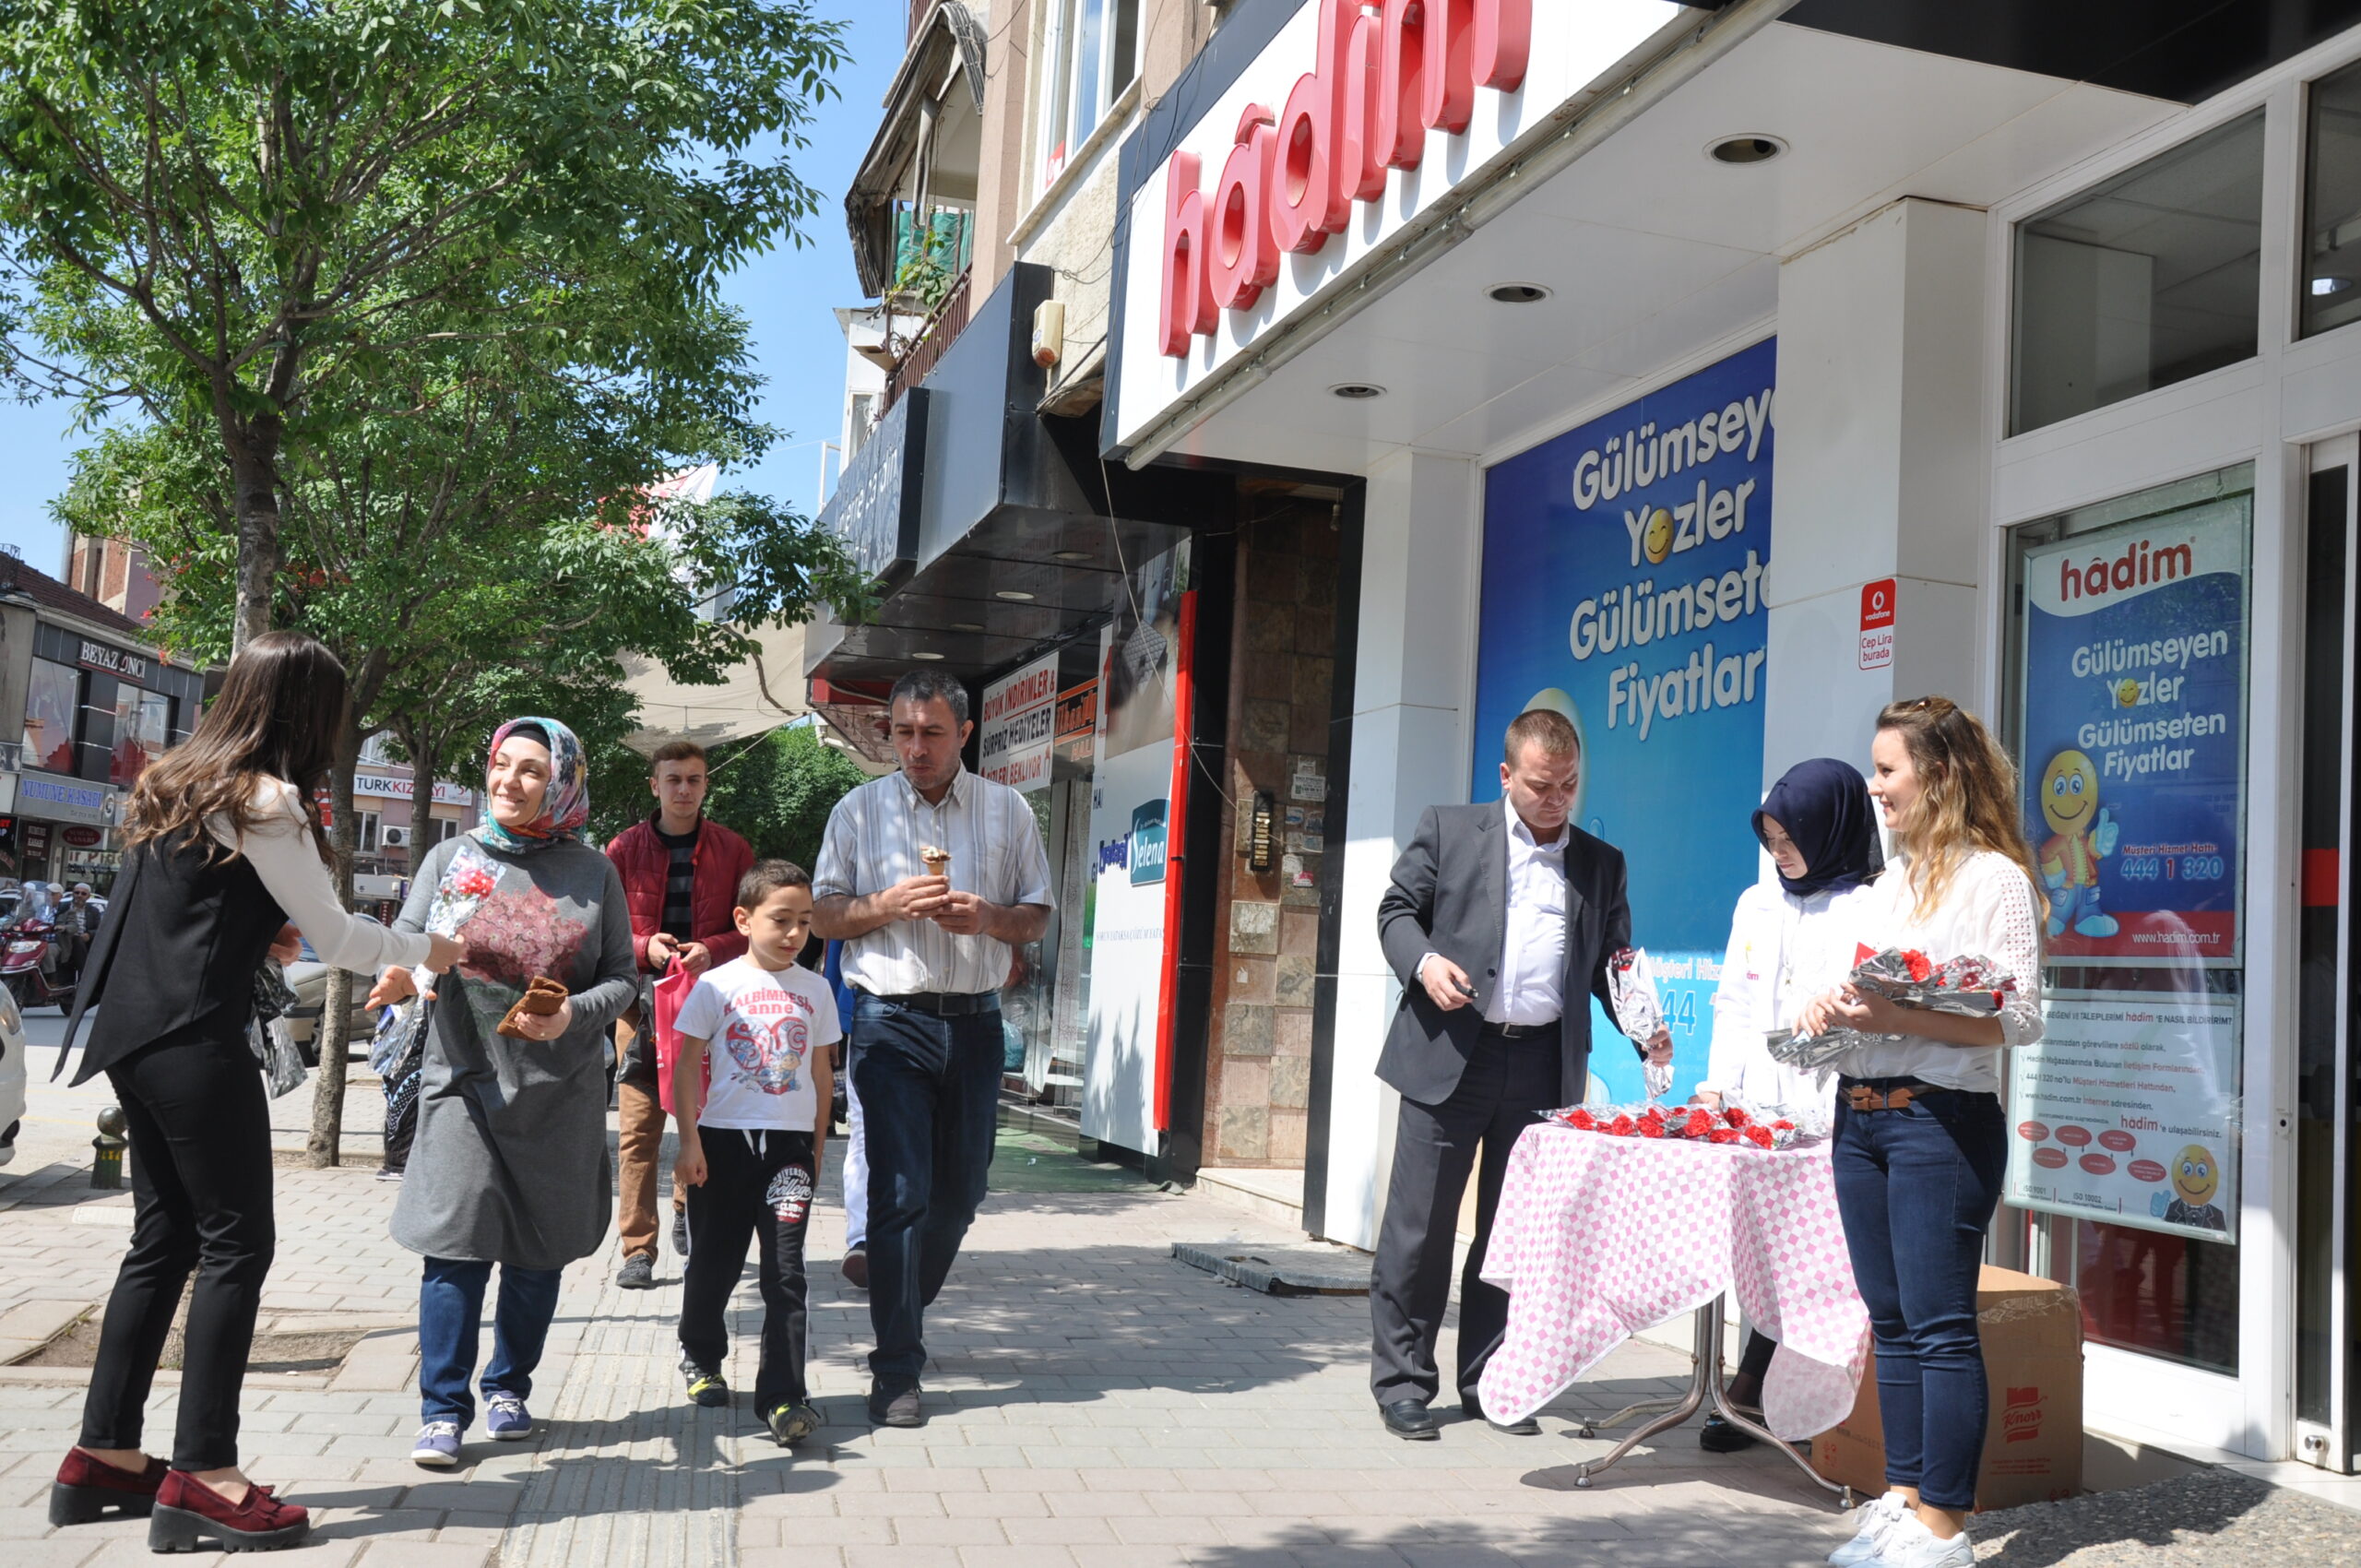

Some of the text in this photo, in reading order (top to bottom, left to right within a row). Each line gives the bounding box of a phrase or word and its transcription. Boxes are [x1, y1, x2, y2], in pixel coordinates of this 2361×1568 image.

[1865, 610, 1892, 621] vodafone
[1862, 634, 1892, 649] Cep Lira
[1863, 647, 1890, 661] burada
[2071, 629, 2228, 678] Gülümseyen
[80, 641, 119, 671] BEYAZ
[983, 692, 1004, 723] BÜYÜK
[1005, 669, 1049, 714] İNDİRİMLER
[1608, 643, 1765, 742] Fiyatlar
[982, 725, 1008, 758] SÜRPRİZ
[1009, 707, 1051, 749] HEDİYELER
[2078, 711, 2226, 749] Gülümseten
[1010, 753, 1042, 785] BEKLİYOR
[2104, 743, 2196, 782] Fiyatlar
[21, 778, 65, 803] NUMUNE
[1132, 818, 1165, 875] Selena
[2123, 843, 2156, 856] Müşteri
[2158, 843, 2189, 854] Hizmet
[2120, 856, 2224, 881] 444 1 320
[2132, 931, 2221, 944] www.hadim.com.tr
[747, 1002, 794, 1015] anne
[2164, 1015, 2186, 1024] NASIL
[766, 1178, 813, 1201] College
[2002, 1408, 2043, 1430] Knorr
